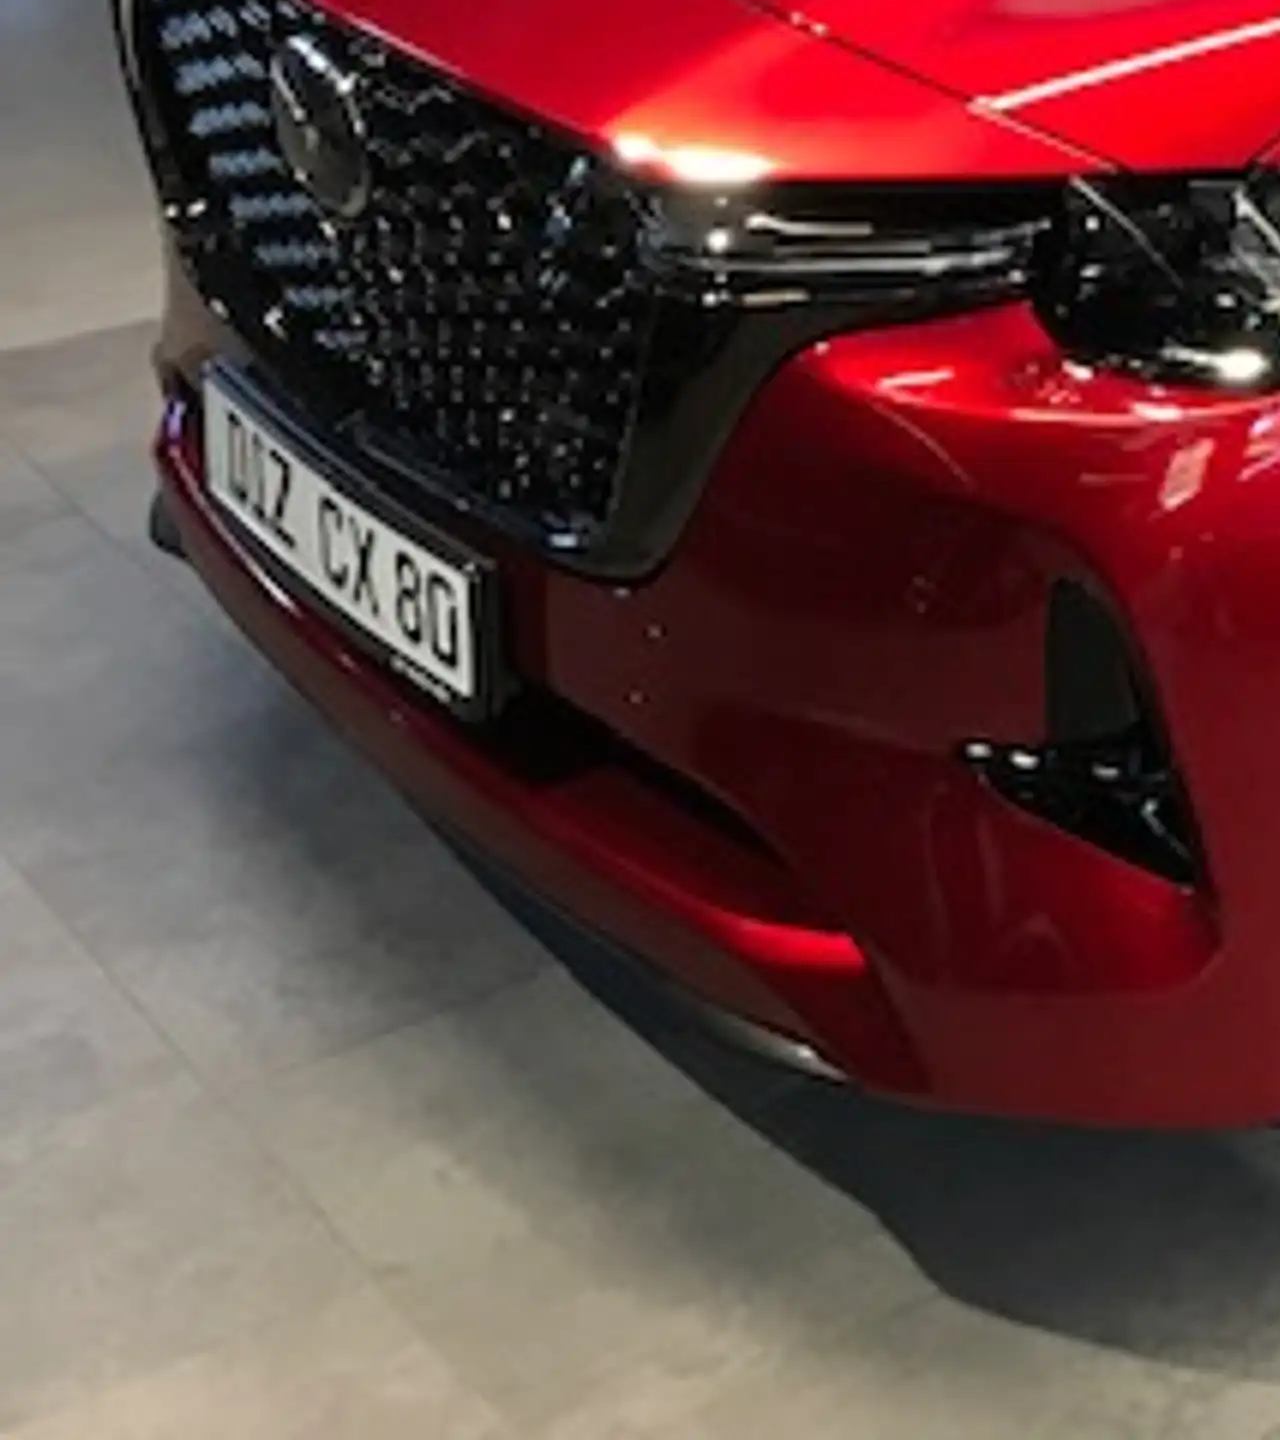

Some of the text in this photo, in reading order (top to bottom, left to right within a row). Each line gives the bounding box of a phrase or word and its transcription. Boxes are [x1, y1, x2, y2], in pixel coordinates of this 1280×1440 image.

[226, 410, 459, 671] DIZ CX 80
